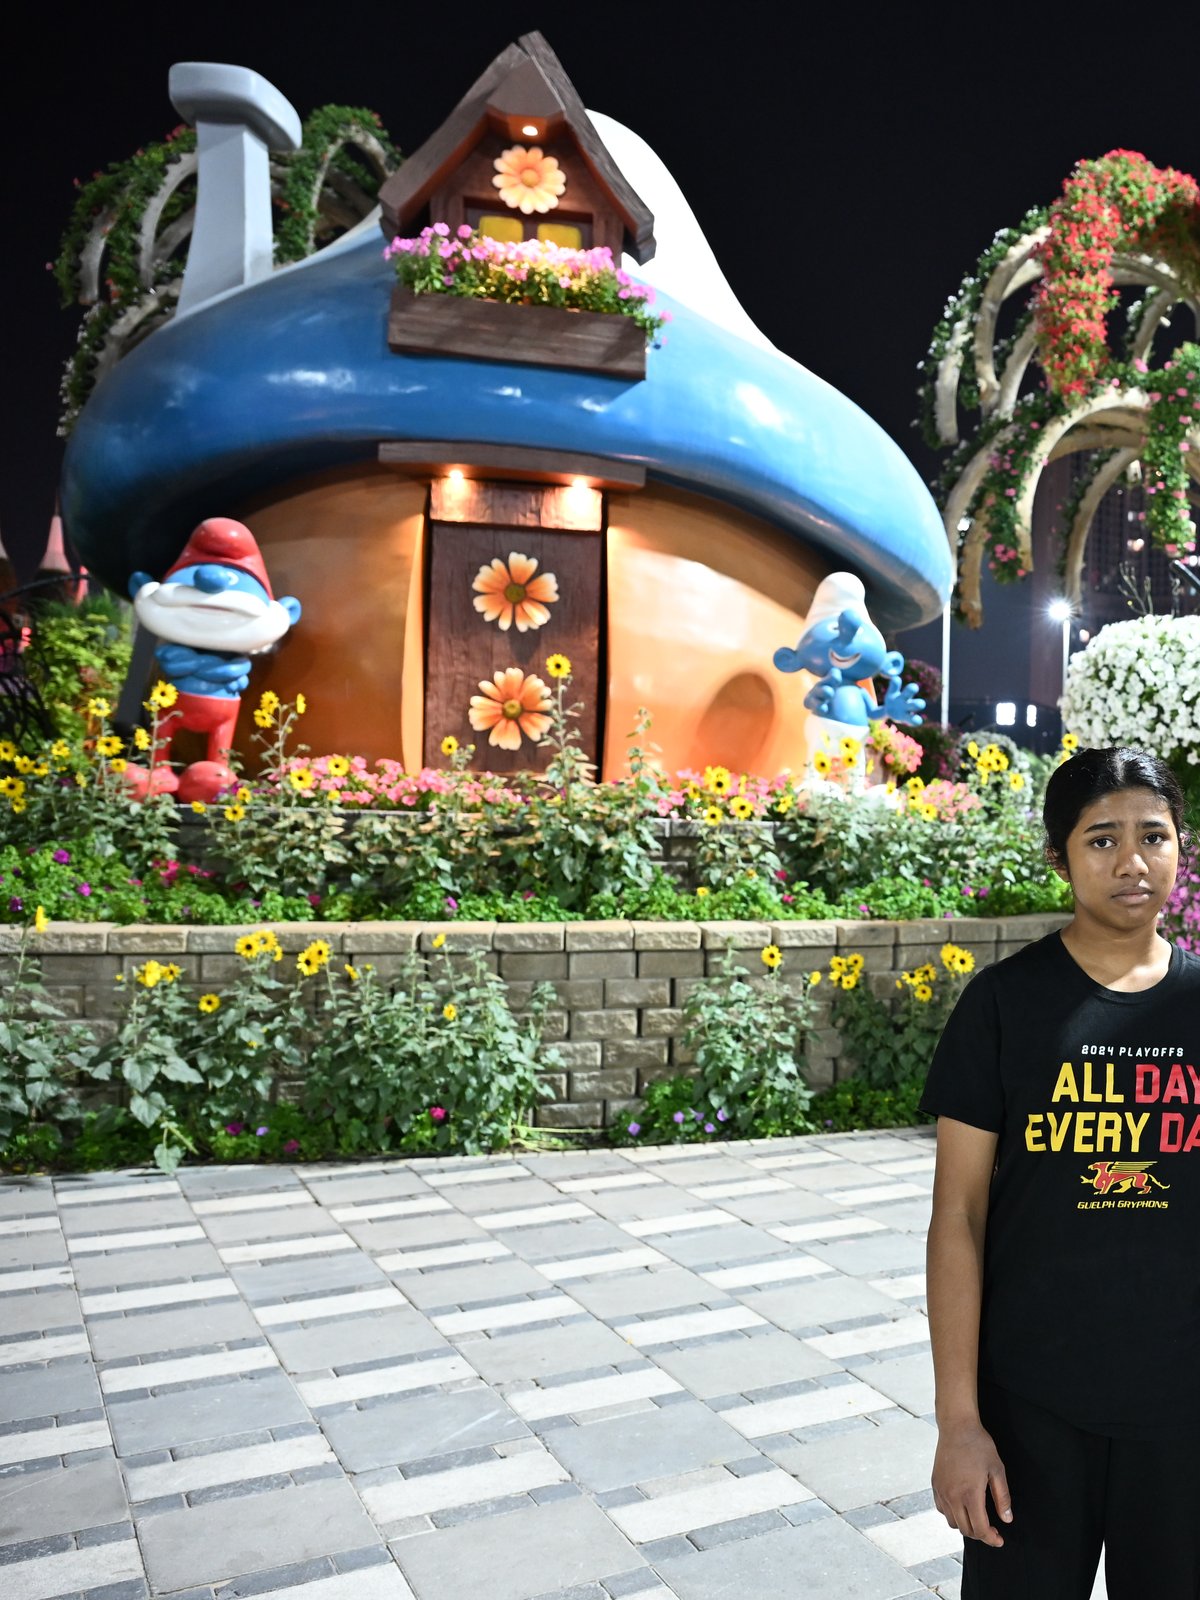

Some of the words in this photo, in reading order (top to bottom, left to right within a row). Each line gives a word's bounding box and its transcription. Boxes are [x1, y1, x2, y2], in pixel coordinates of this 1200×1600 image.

[1081, 1044, 1114, 1057] 2024
[1119, 1046, 1184, 1058] PLAYOFFS
[1051, 1061, 1125, 1104] ALL
[1024, 1111, 1151, 1153] EVERY
[1077, 1200, 1116, 1210] GUELPH
[1117, 1200, 1169, 1209] GRYPHONS
